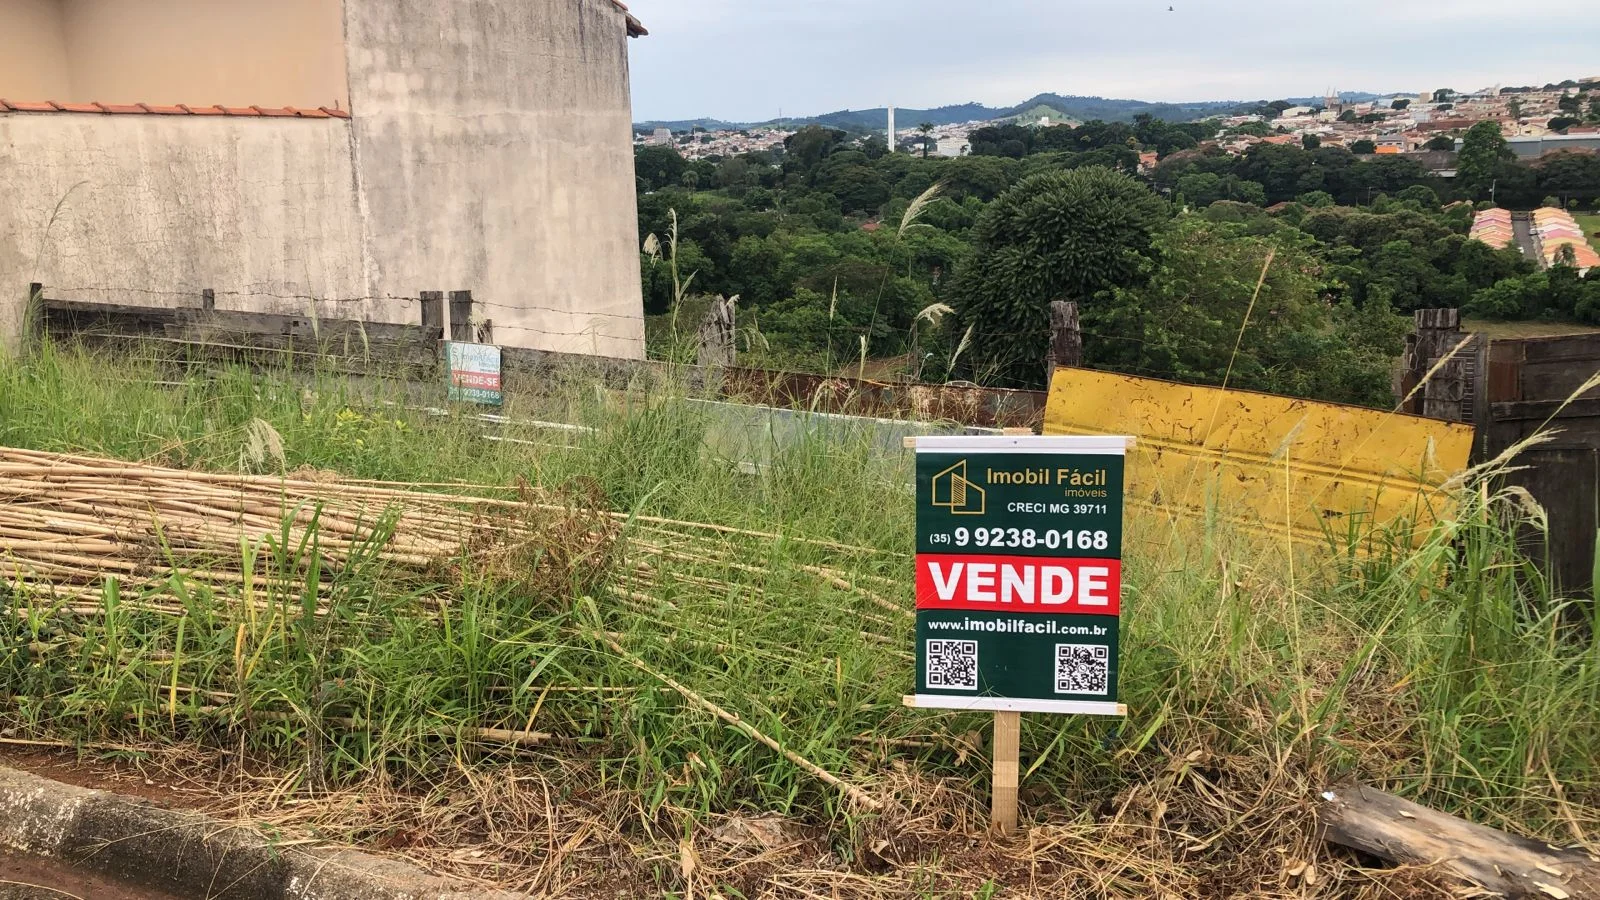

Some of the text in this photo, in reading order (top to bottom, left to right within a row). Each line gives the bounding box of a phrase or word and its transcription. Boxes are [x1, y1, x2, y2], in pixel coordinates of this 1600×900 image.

[453, 373, 499, 387] VENDE-SE
[987, 468, 1106, 486] Imobil Fácil
[1064, 487, 1107, 498] imóveis
[1007, 502, 1107, 515] CRECI MG 39711
[929, 527, 1108, 550] (35) 9 9238-0168
[928, 562, 1109, 606] VENDE
[928, 617, 1107, 636] www.imobilfacil.com.br
